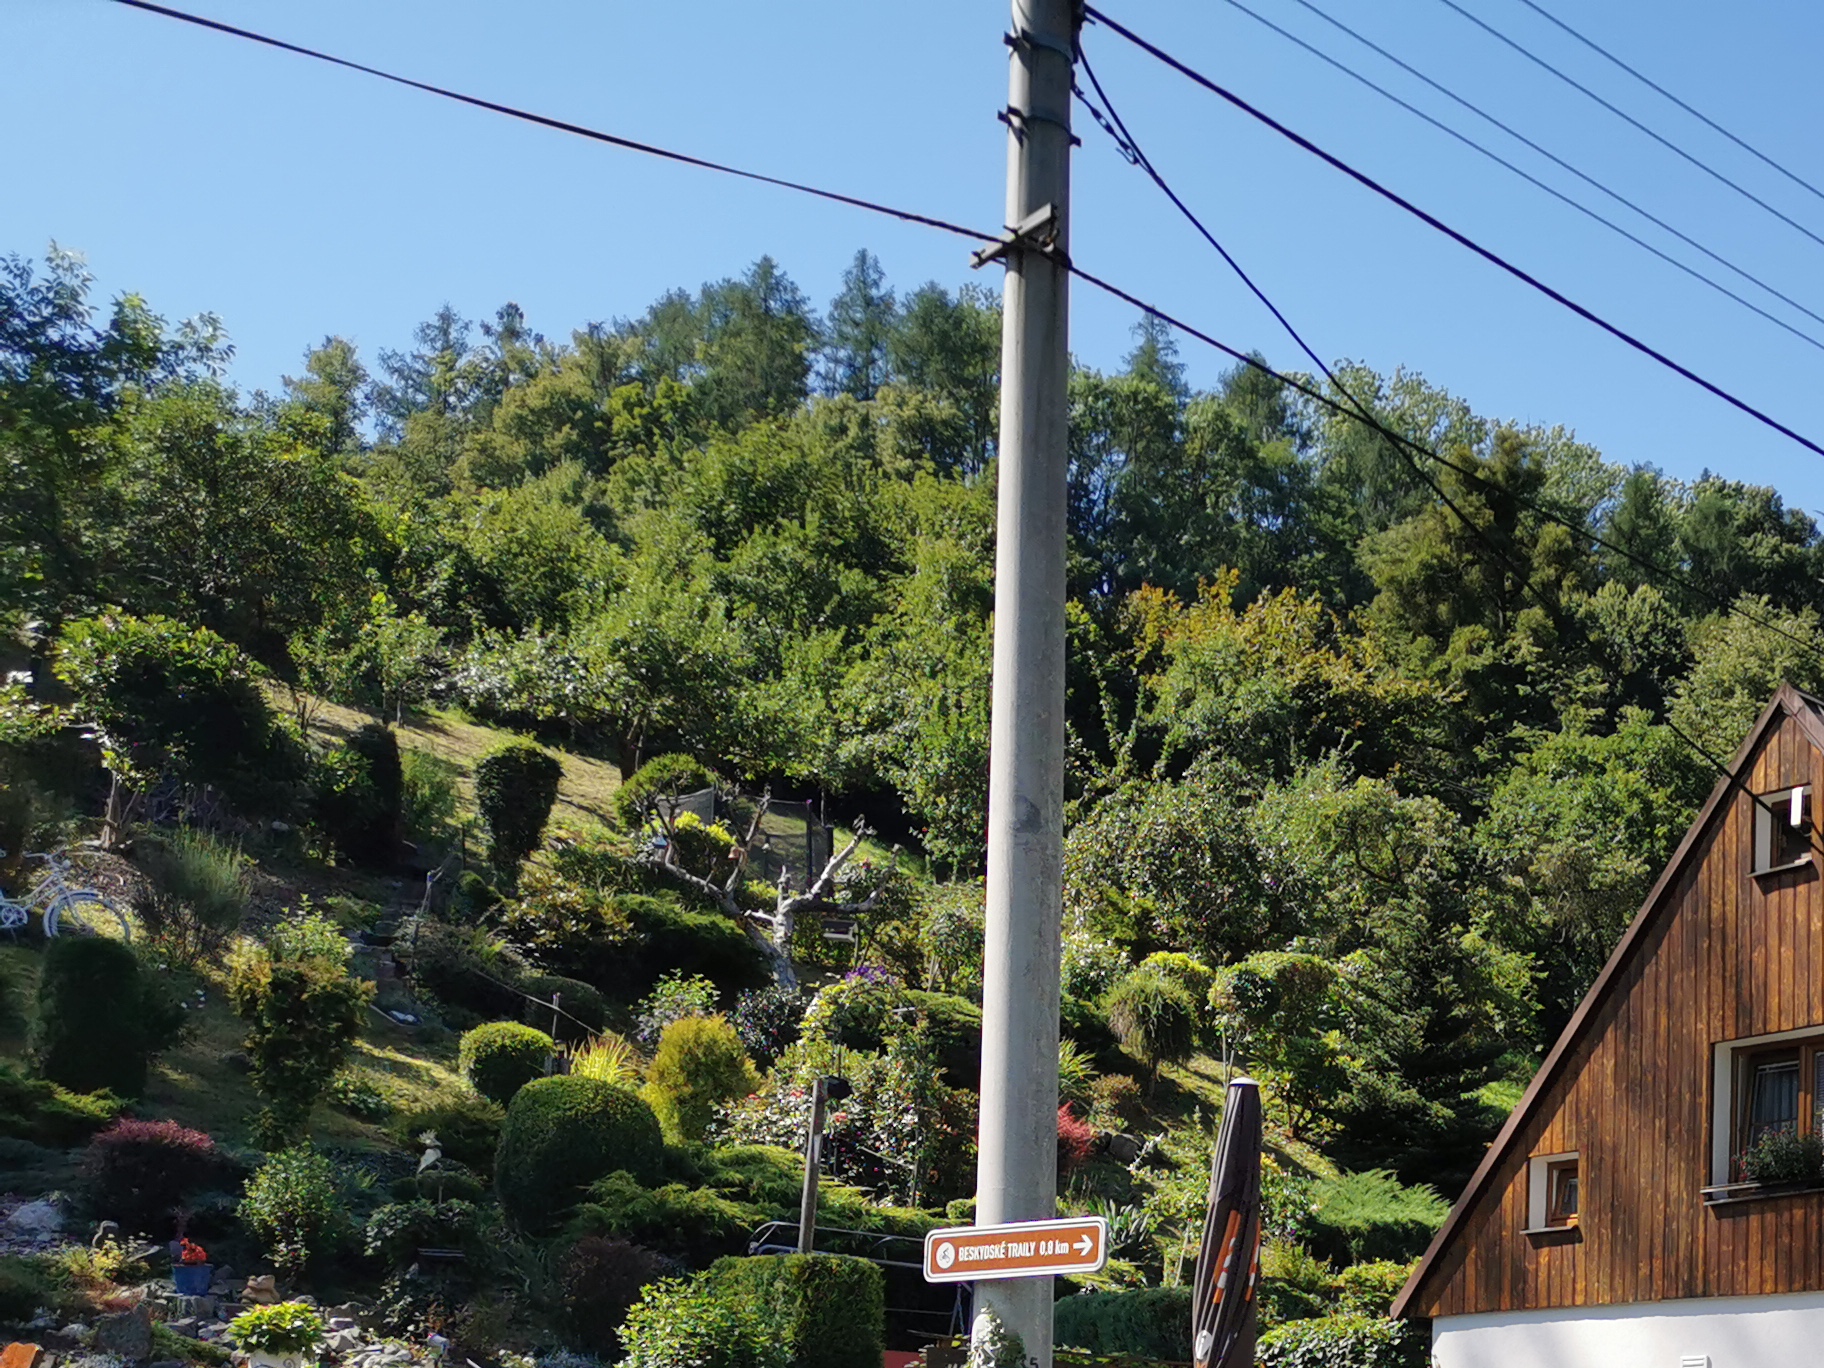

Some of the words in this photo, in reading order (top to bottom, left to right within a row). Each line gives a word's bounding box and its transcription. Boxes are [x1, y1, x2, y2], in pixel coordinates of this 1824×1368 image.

[958, 1241, 1006, 1262] BESKYDSKÉ
[1007, 1241, 1036, 1259] TRAILY
[1039, 1240, 1053, 1257] 0,8
[1054, 1239, 1070, 1255] km
